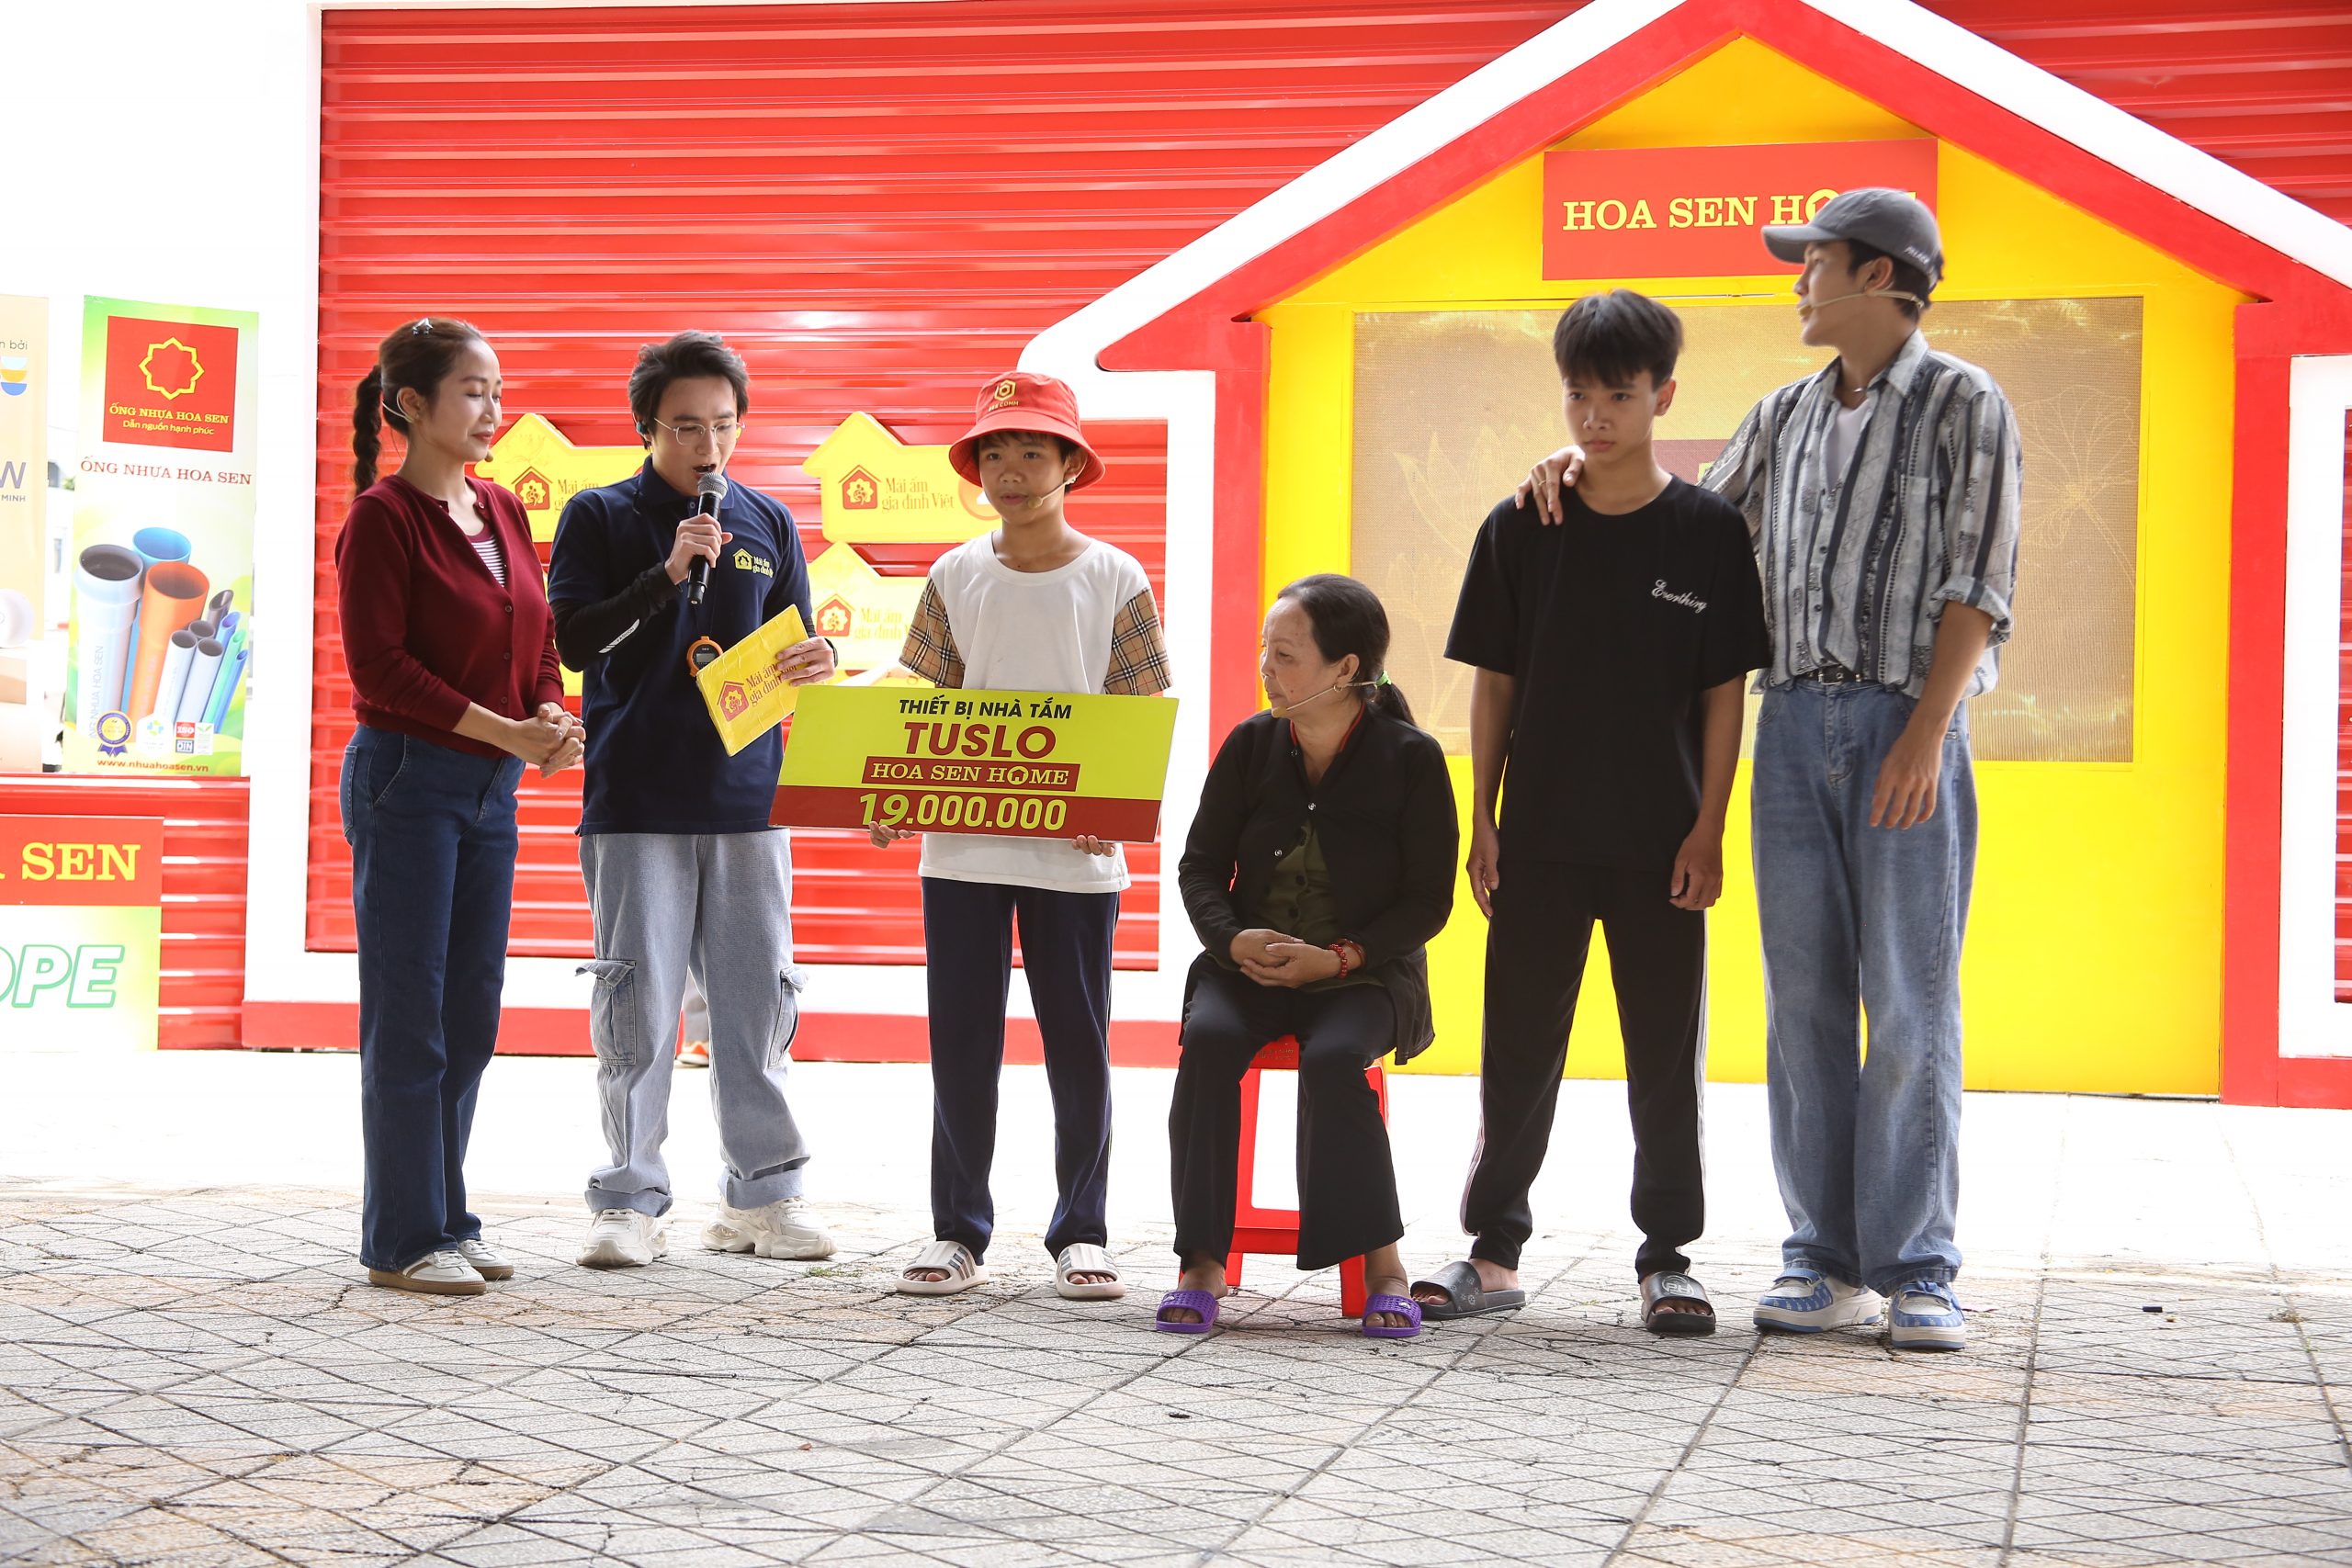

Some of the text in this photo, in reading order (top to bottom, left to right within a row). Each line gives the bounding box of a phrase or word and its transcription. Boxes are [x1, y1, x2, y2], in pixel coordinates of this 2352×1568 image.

[1563, 199, 1657, 231] HOA
[1668, 196, 1758, 228] SEN
[109, 402, 230, 424] ỐNG NHỰA HOA SEN
[122, 419, 215, 435] Dẫn nguồn hạnh phúc
[80, 455, 119, 474] ỐNG
[176, 468, 213, 482] HOA
[218, 472, 253, 485] SEN
[885, 476, 929, 493] Mái ấm
[1, 493, 27, 502] MINH
[882, 491, 955, 513] gia đình Việt
[745, 671, 763, 691] Mái
[750, 690, 763, 707] gia
[899, 694, 1072, 720] THIẾT BỊ NHÀ TẮM
[903, 721, 1057, 760] TUSLO
[96, 759, 209, 773] www.nhuahoasen.vn
[870, 762, 1069, 785] HOA SEN HOME
[859, 793, 1068, 831] 19.000.000
[22, 842, 141, 881] SEN
